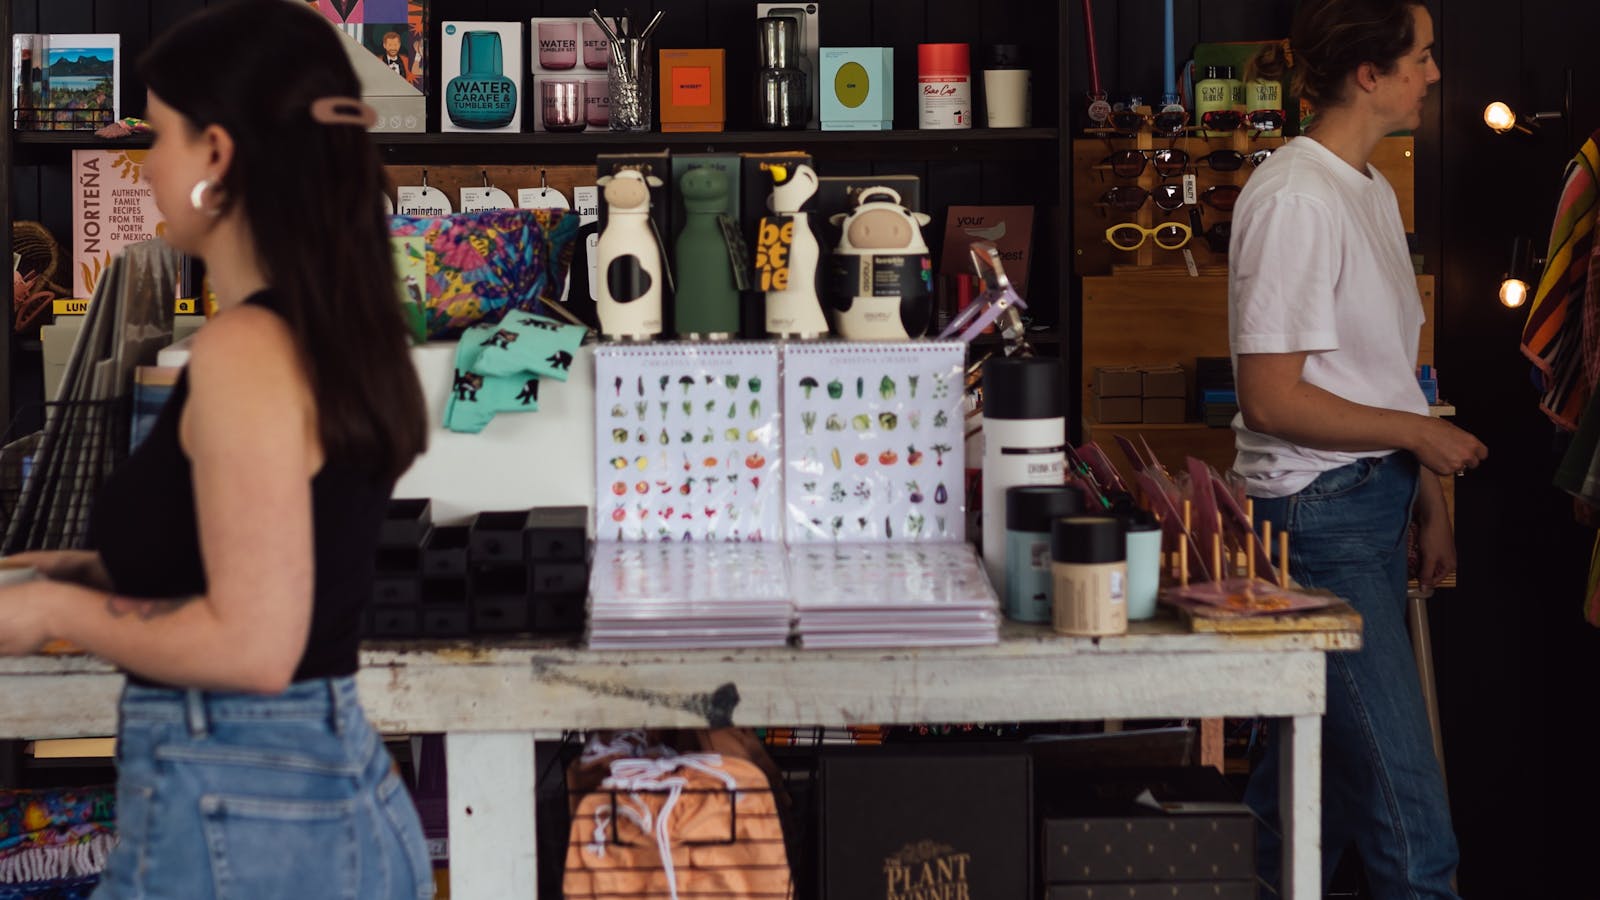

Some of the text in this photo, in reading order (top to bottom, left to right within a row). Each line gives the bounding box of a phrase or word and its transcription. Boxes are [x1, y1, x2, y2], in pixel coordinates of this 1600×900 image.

[454, 81, 510, 93] WATER
[454, 93, 510, 102] CARAFE &
[111, 189, 151, 197] AUTHENTIC
[80, 157, 101, 253] NORTEÑA
[114, 198, 140, 206] FAMILY
[113, 206, 141, 215] RECIPES
[401, 205, 443, 216] Lamington
[578, 205, 598, 216] Lami
[108, 215, 145, 223] FROM THE
[956, 215, 985, 227] your
[117, 224, 142, 232] NORTH
[759, 217, 794, 245] be
[110, 233, 152, 241] OF MEXICO
[66, 303, 87, 312] LUN
[884, 854, 970, 892] PLANT
